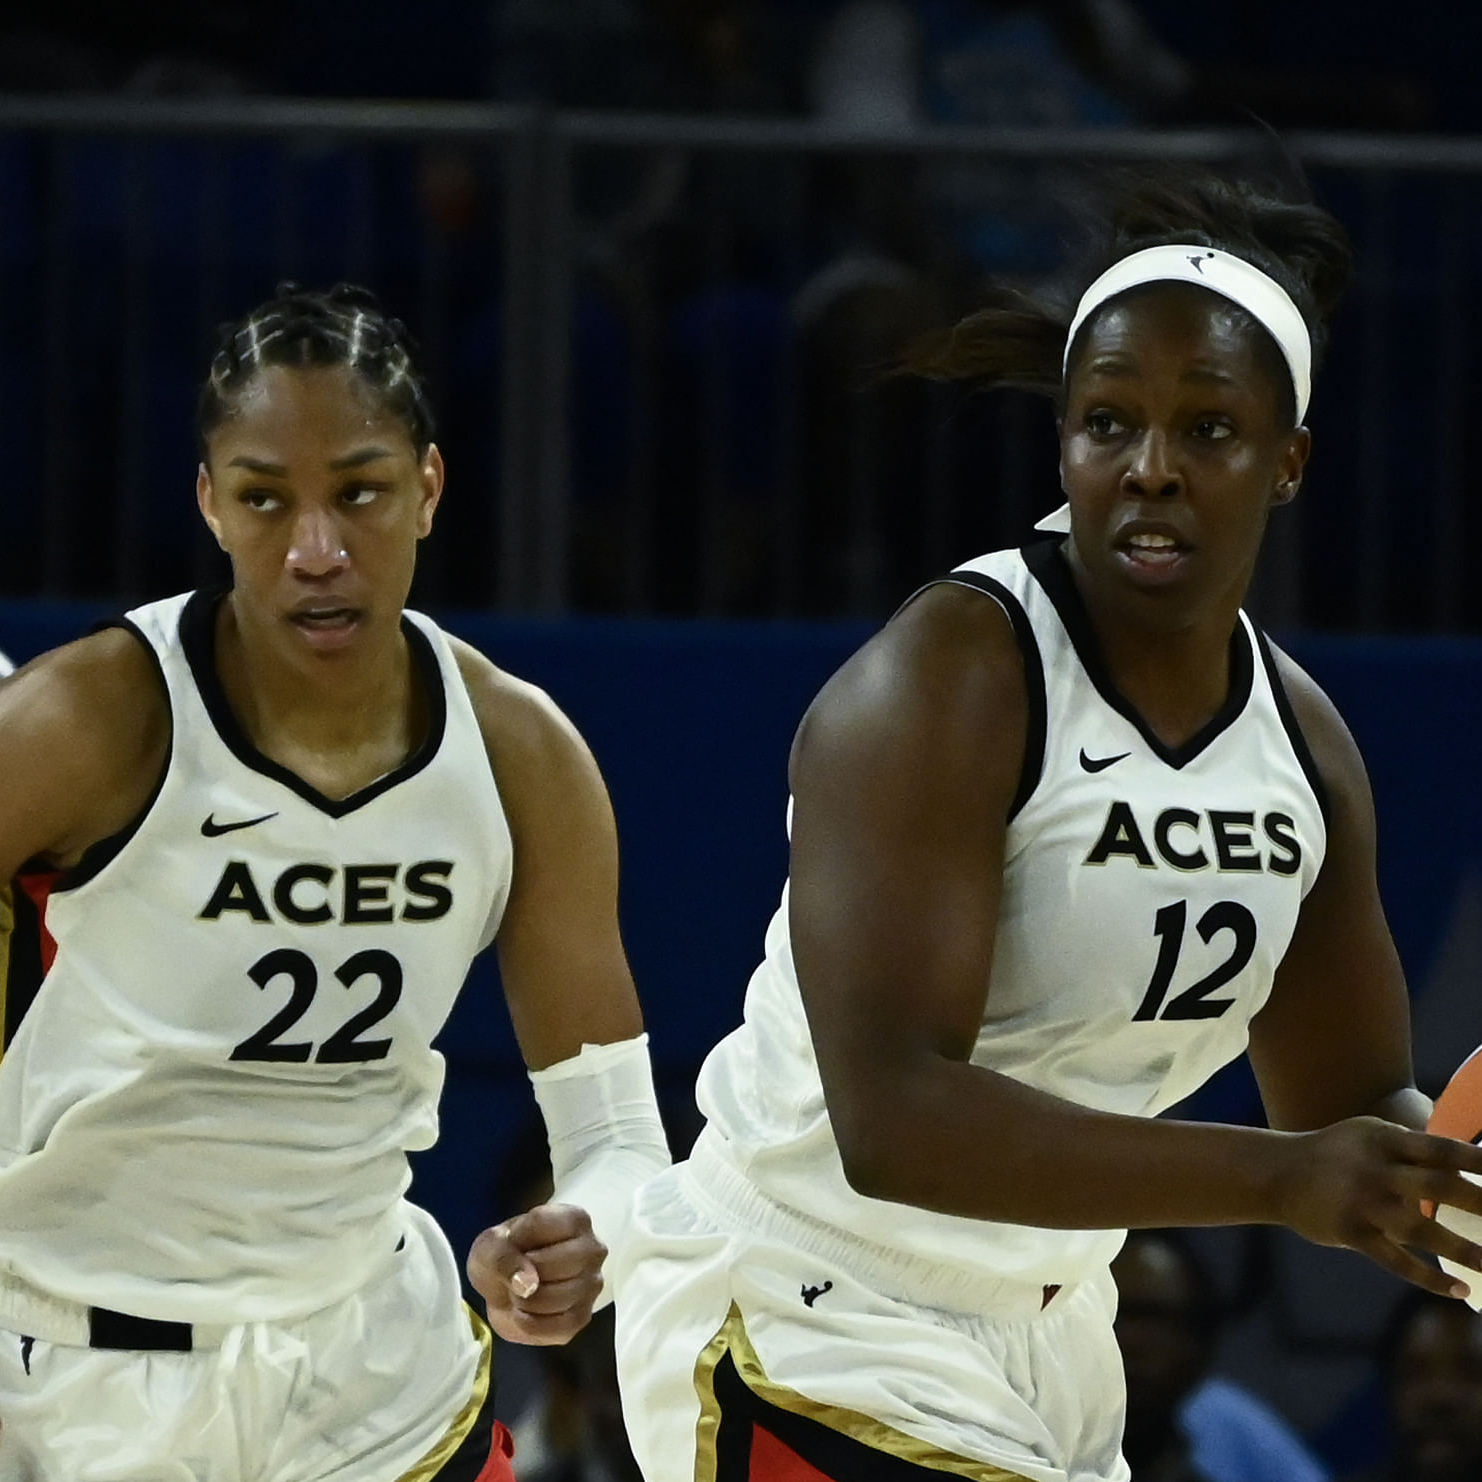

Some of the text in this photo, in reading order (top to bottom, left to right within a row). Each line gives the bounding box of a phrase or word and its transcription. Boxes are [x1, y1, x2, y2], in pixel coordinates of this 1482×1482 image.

[1083, 800, 1303, 877] ACES
[198, 860, 456, 925] ACES
[228, 948, 405, 1064] 22
[1131, 900, 1257, 1021] 12
